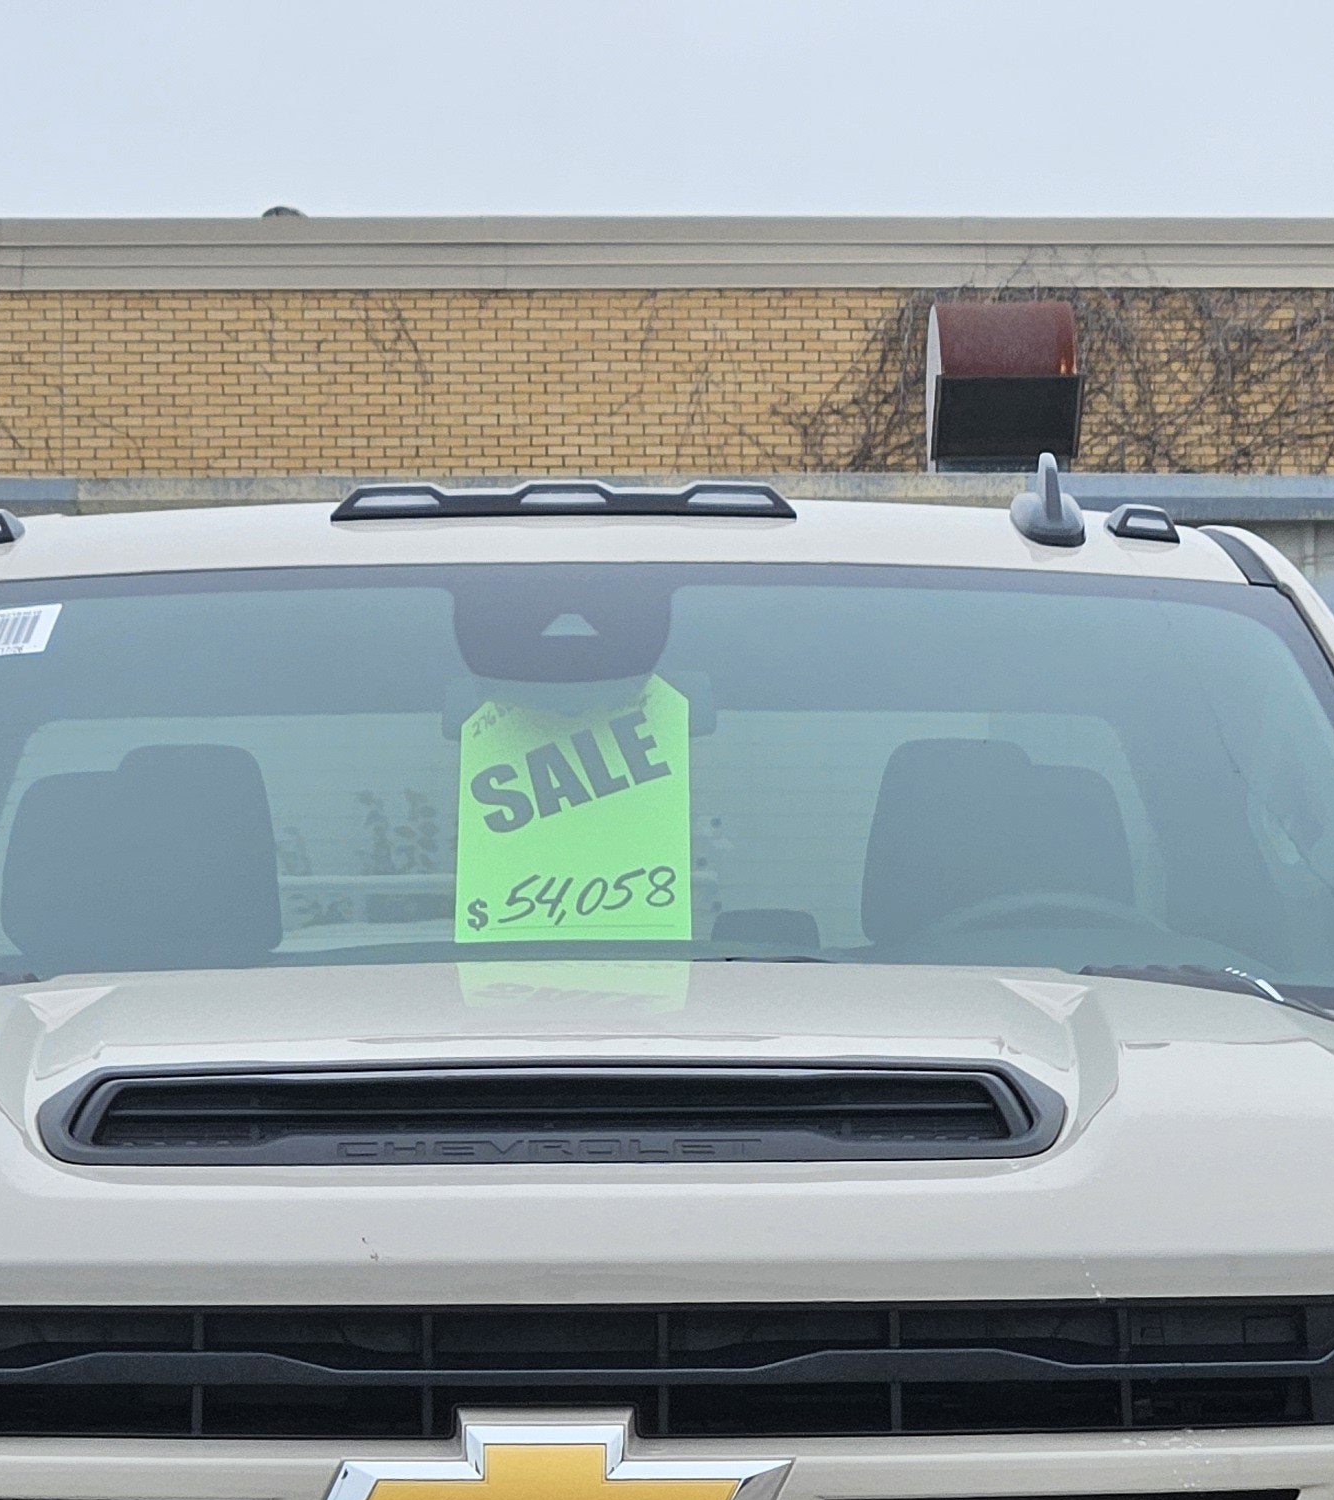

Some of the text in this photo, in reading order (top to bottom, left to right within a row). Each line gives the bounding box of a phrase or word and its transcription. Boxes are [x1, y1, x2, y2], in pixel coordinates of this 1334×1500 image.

[470, 711, 672, 833] SALE
[498, 865, 677, 926] 54,058
[336, 1138, 763, 1158] CHEVROLET
